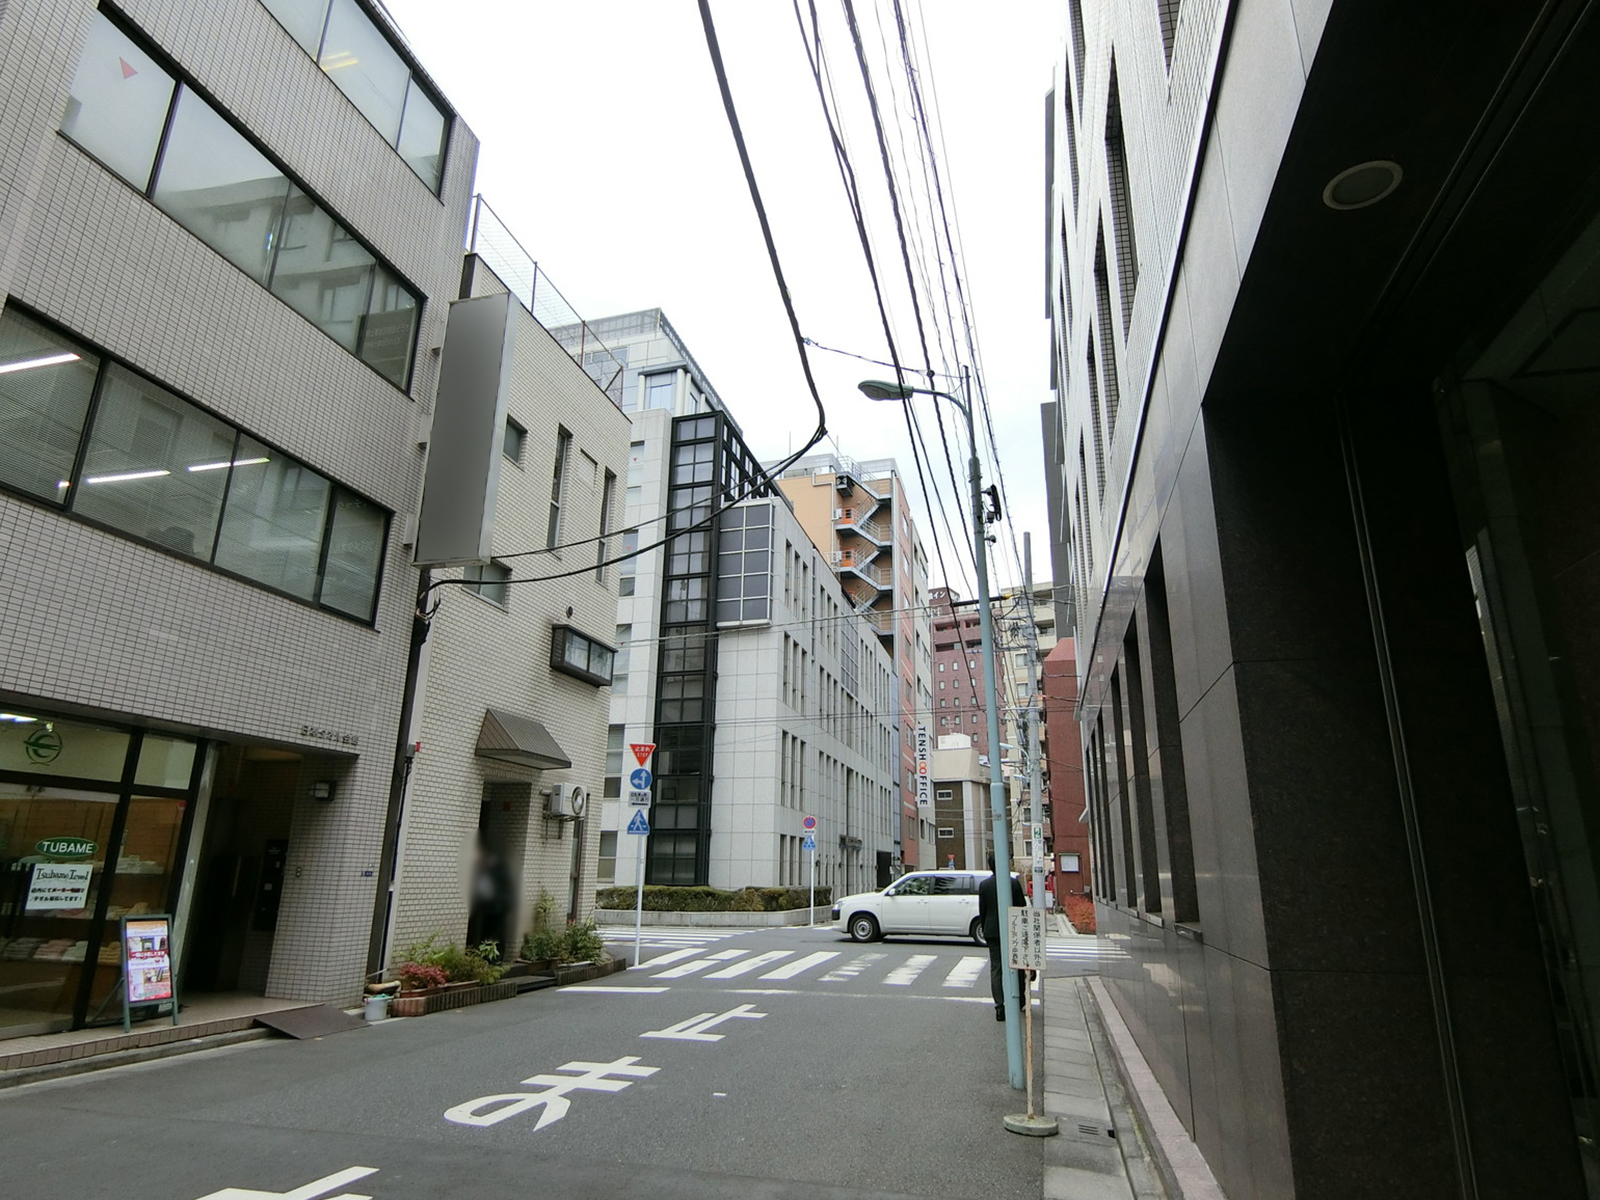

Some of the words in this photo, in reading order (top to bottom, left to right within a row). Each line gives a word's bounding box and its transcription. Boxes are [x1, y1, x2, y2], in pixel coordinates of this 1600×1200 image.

[42, 841, 94, 853] TUBAME
[36, 868, 69, 880] Tsubame
[69, 870, 89, 880] Towel
[1033, 911, 1042, 966] 当社関係者以外の
